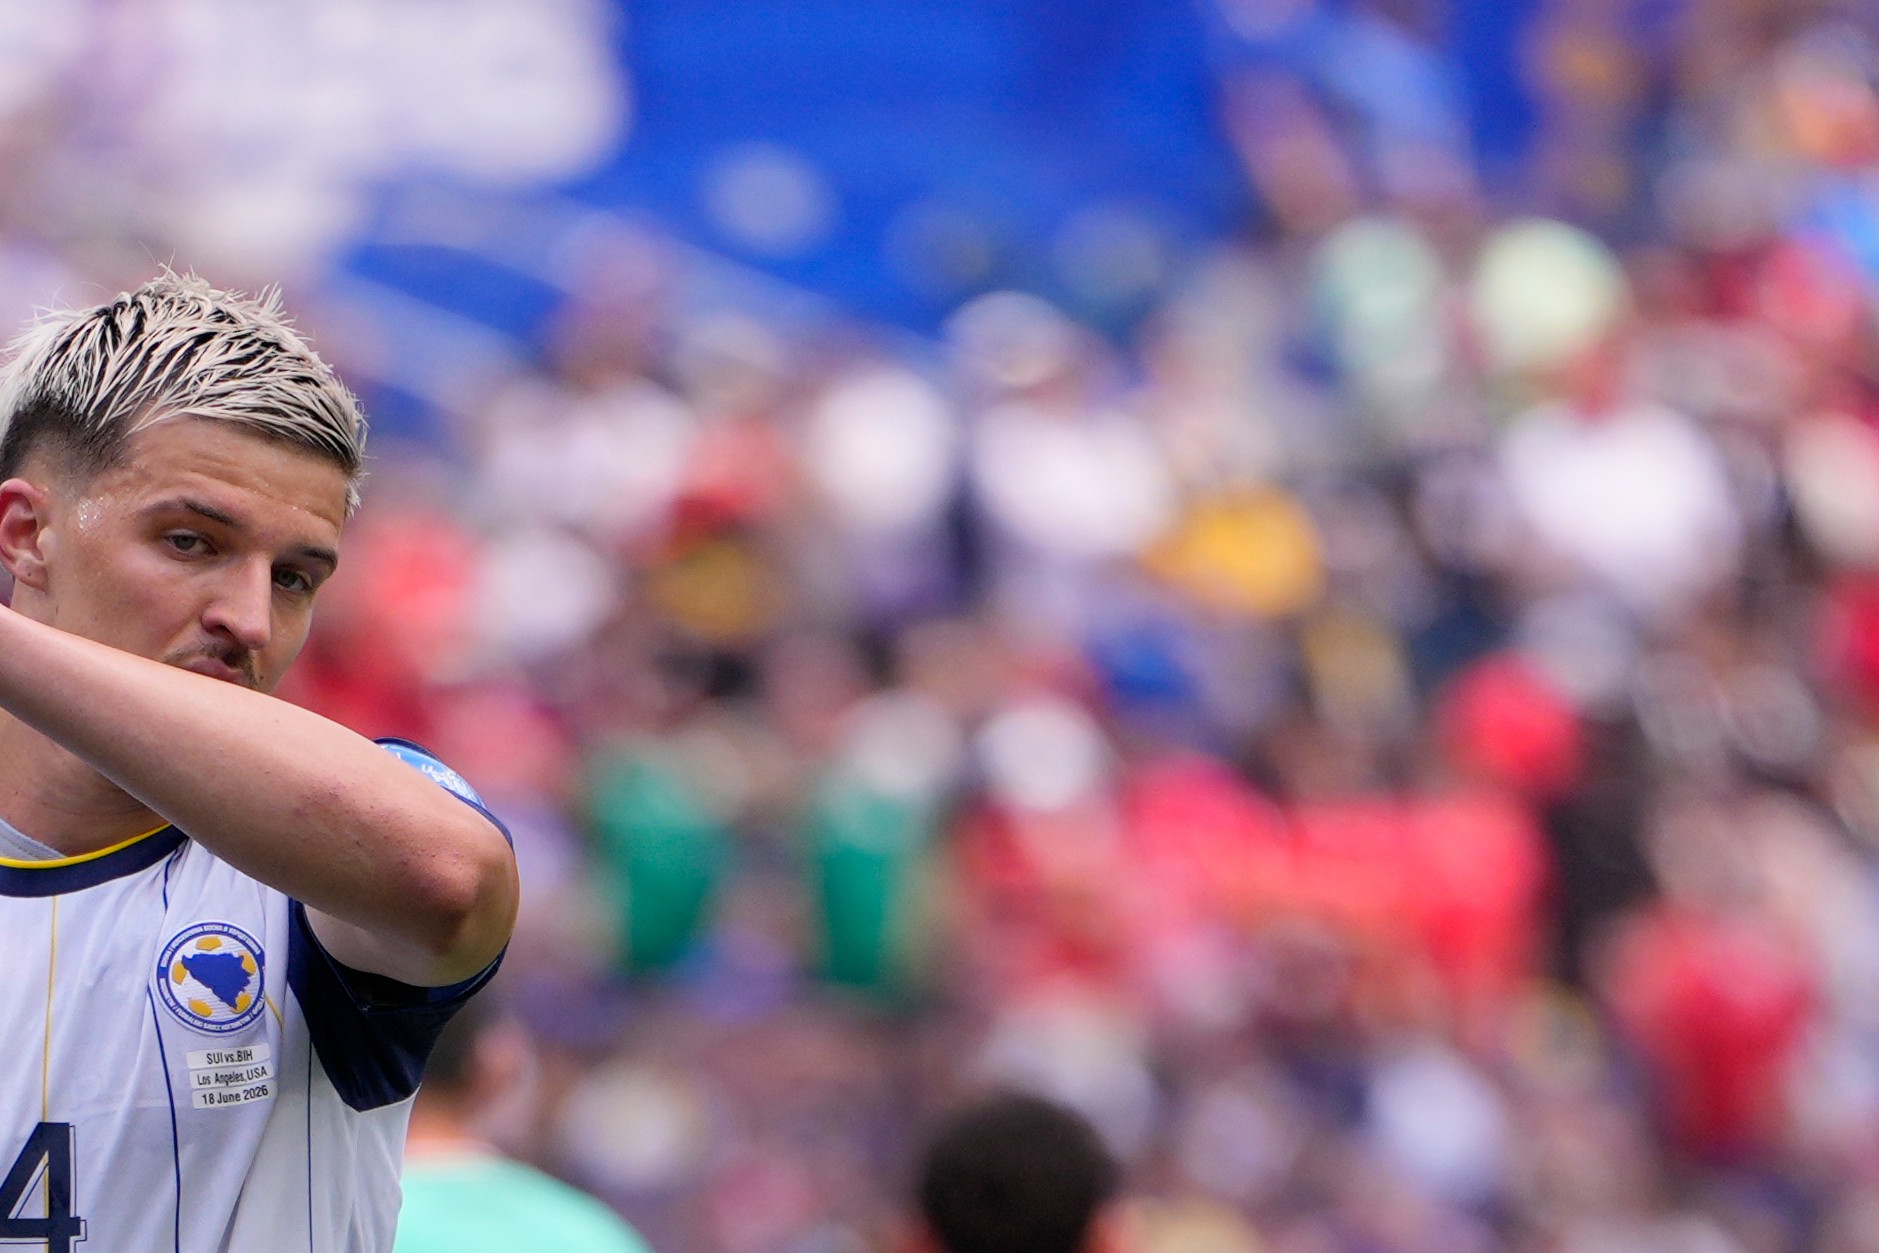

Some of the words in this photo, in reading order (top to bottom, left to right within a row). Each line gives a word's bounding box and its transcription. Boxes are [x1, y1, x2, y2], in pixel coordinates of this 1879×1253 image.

[206, 1053, 223, 1065] SUI
[197, 1074, 211, 1086] Los
[247, 1066, 268, 1081] USA
[202, 1093, 215, 1104] 18
[217, 1092, 241, 1104] June
[243, 1085, 268, 1100] 2026
